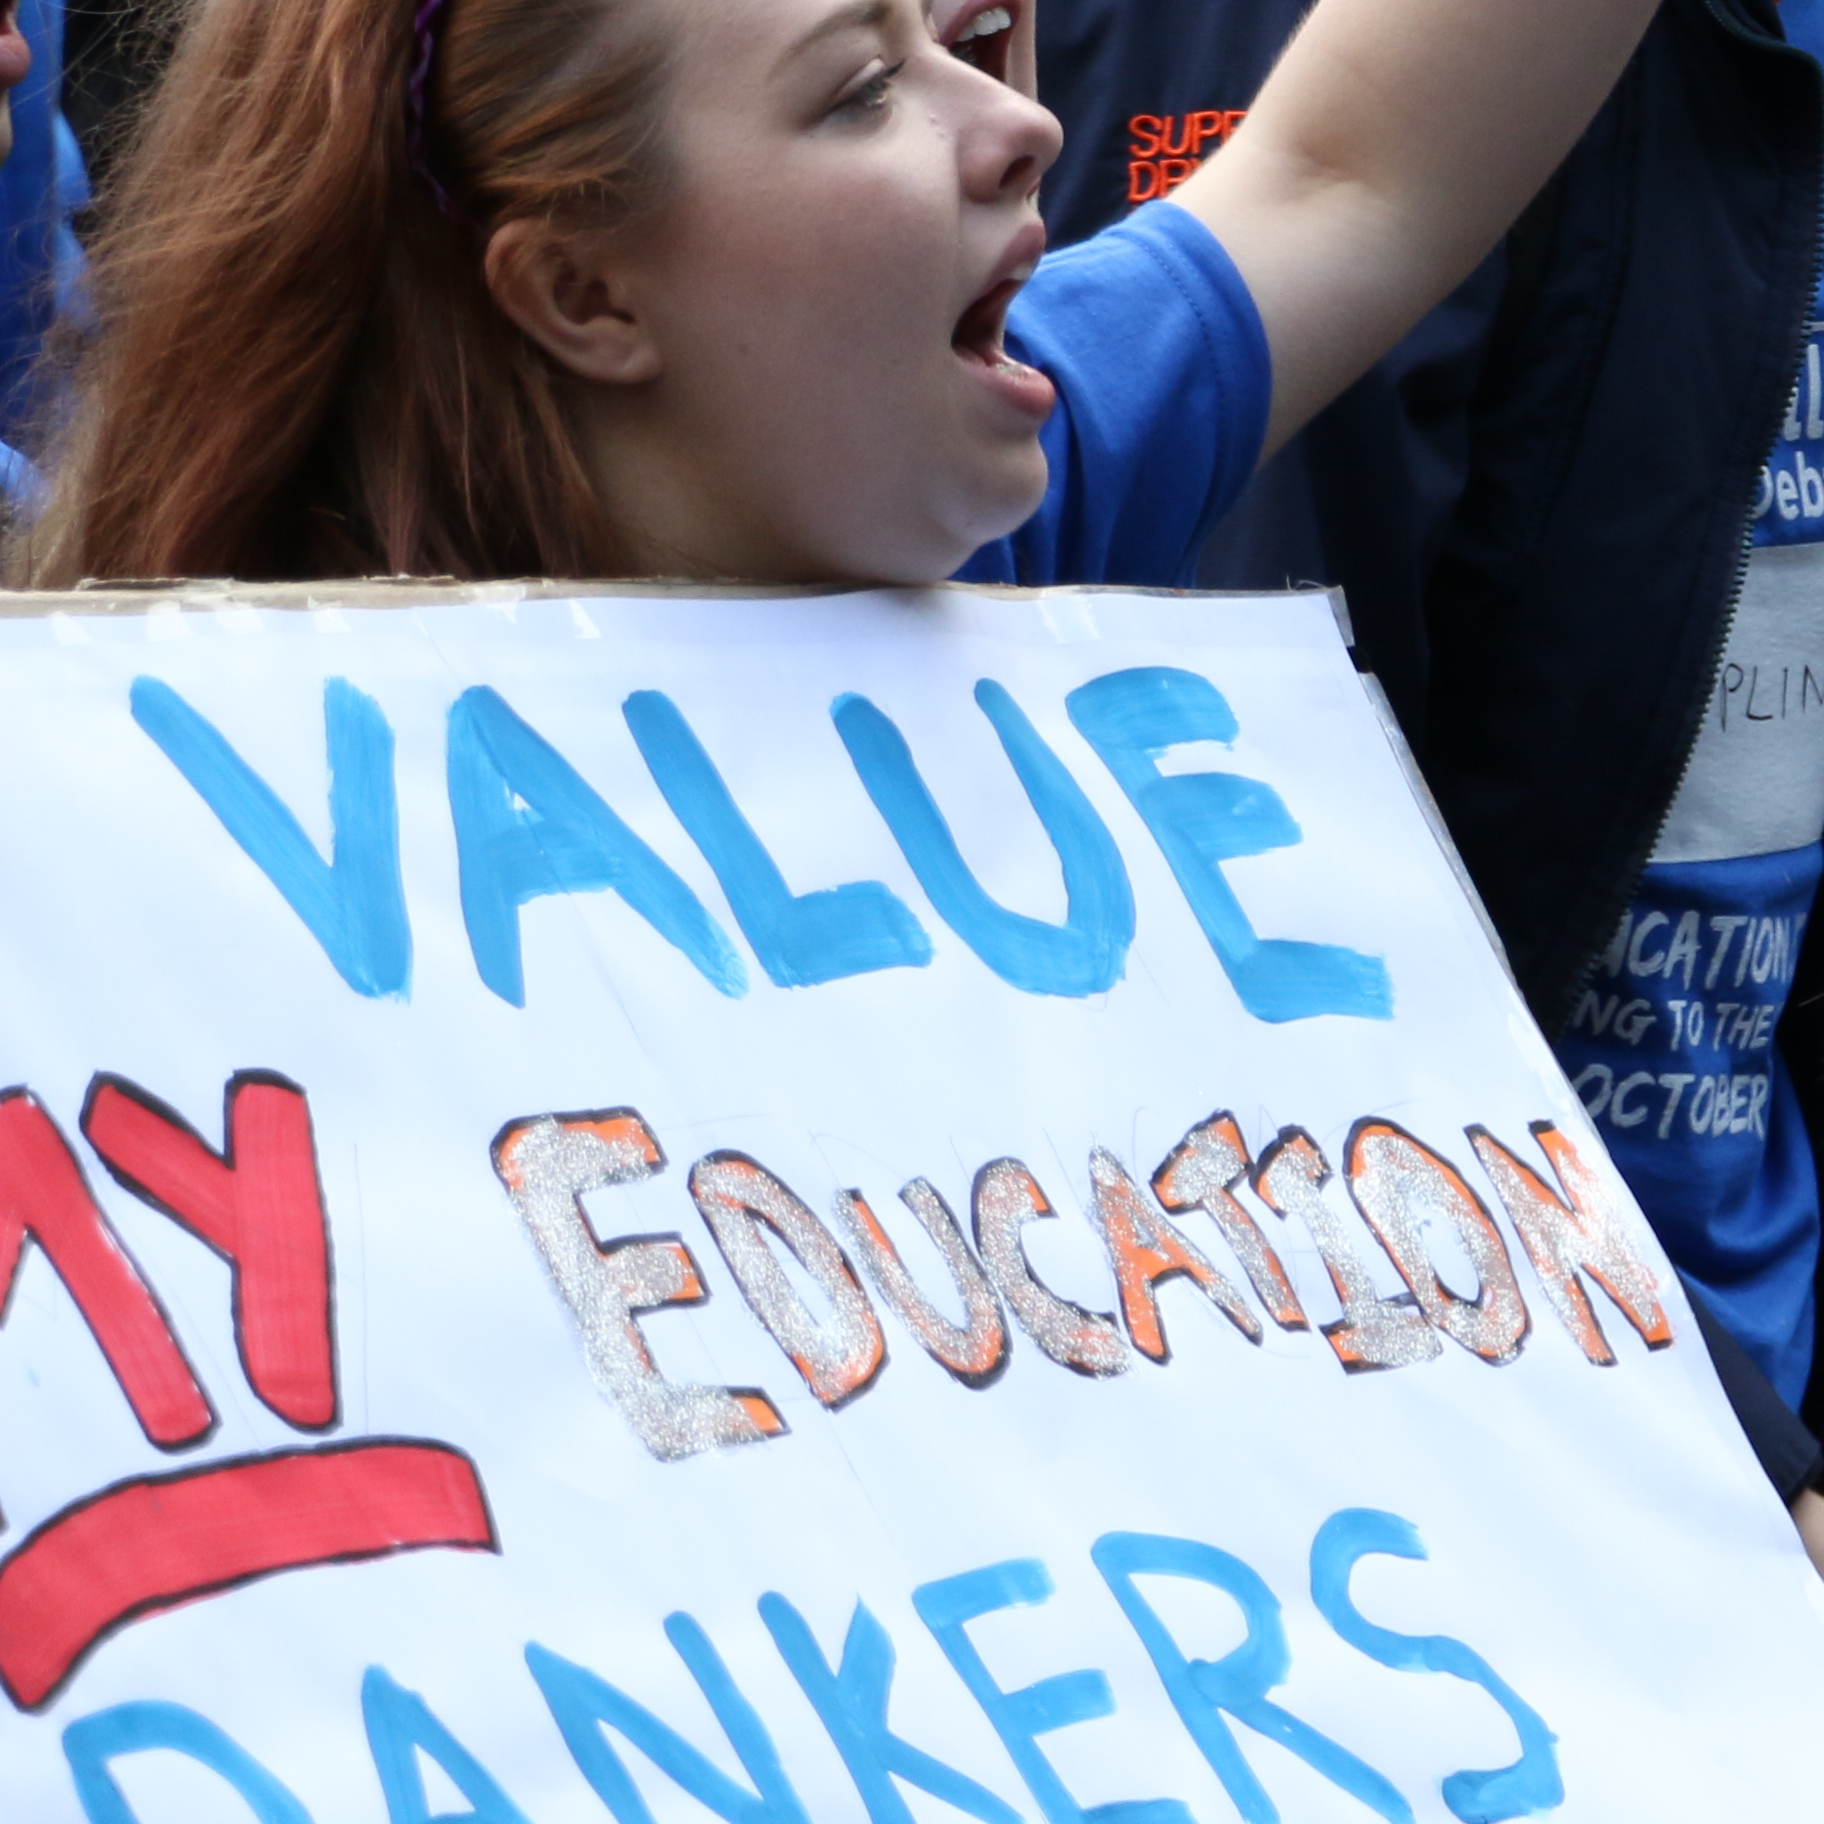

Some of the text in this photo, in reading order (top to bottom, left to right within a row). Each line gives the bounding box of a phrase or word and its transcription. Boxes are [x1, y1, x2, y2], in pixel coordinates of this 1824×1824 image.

[129, 666, 1393, 1023] VALUE
[1573, 1063, 1770, 1141] OCTOBER
[1661, 1000, 1705, 1051] TO
[1715, 1002, 1775, 1052] THE
[490, 1104, 1675, 1463] EDUCATION
